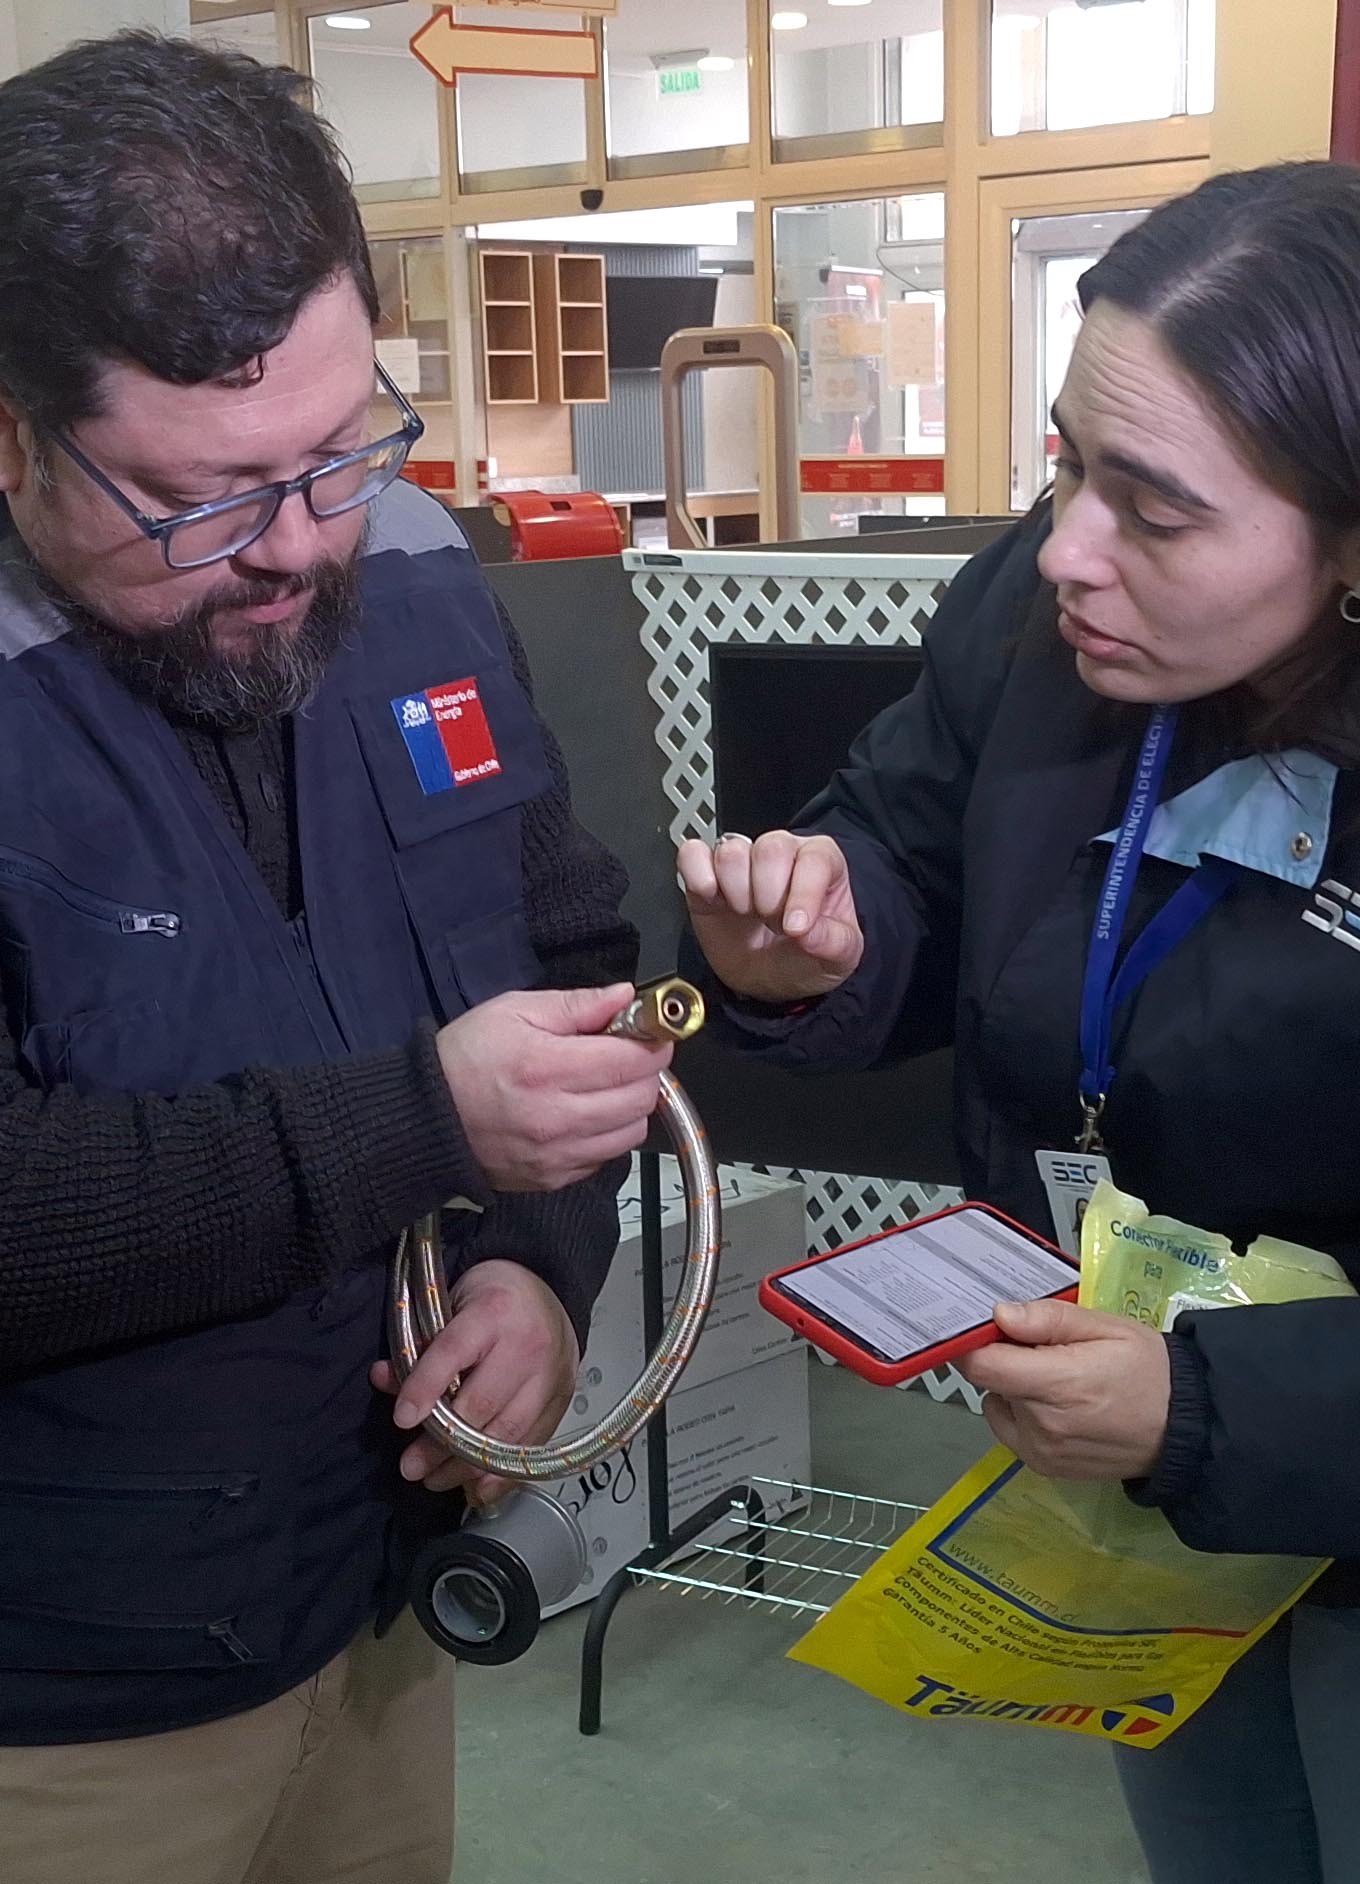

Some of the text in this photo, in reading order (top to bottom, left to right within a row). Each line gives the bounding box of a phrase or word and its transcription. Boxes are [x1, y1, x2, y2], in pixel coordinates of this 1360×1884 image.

[660, 72, 700, 93] SALIDA
[1098, 793, 1147, 940] SUPERINTENDENCIA
[1138, 770, 1152, 791] DE
[1051, 1161, 1097, 1185] SEC
[883, 1588, 982, 1654] Garantía 5 Años
[894, 1575, 980, 1635] Componentes
[981, 1634, 999, 1646] de
[1000, 1642, 1025, 1656] Alta
[917, 1556, 986, 1605] Certificado
[988, 1604, 1006, 1617] en
[1008, 1615, 1039, 1634] Chile
[995, 1625, 1051, 1650] Nacional
[904, 1674, 1094, 1726] Täumm
